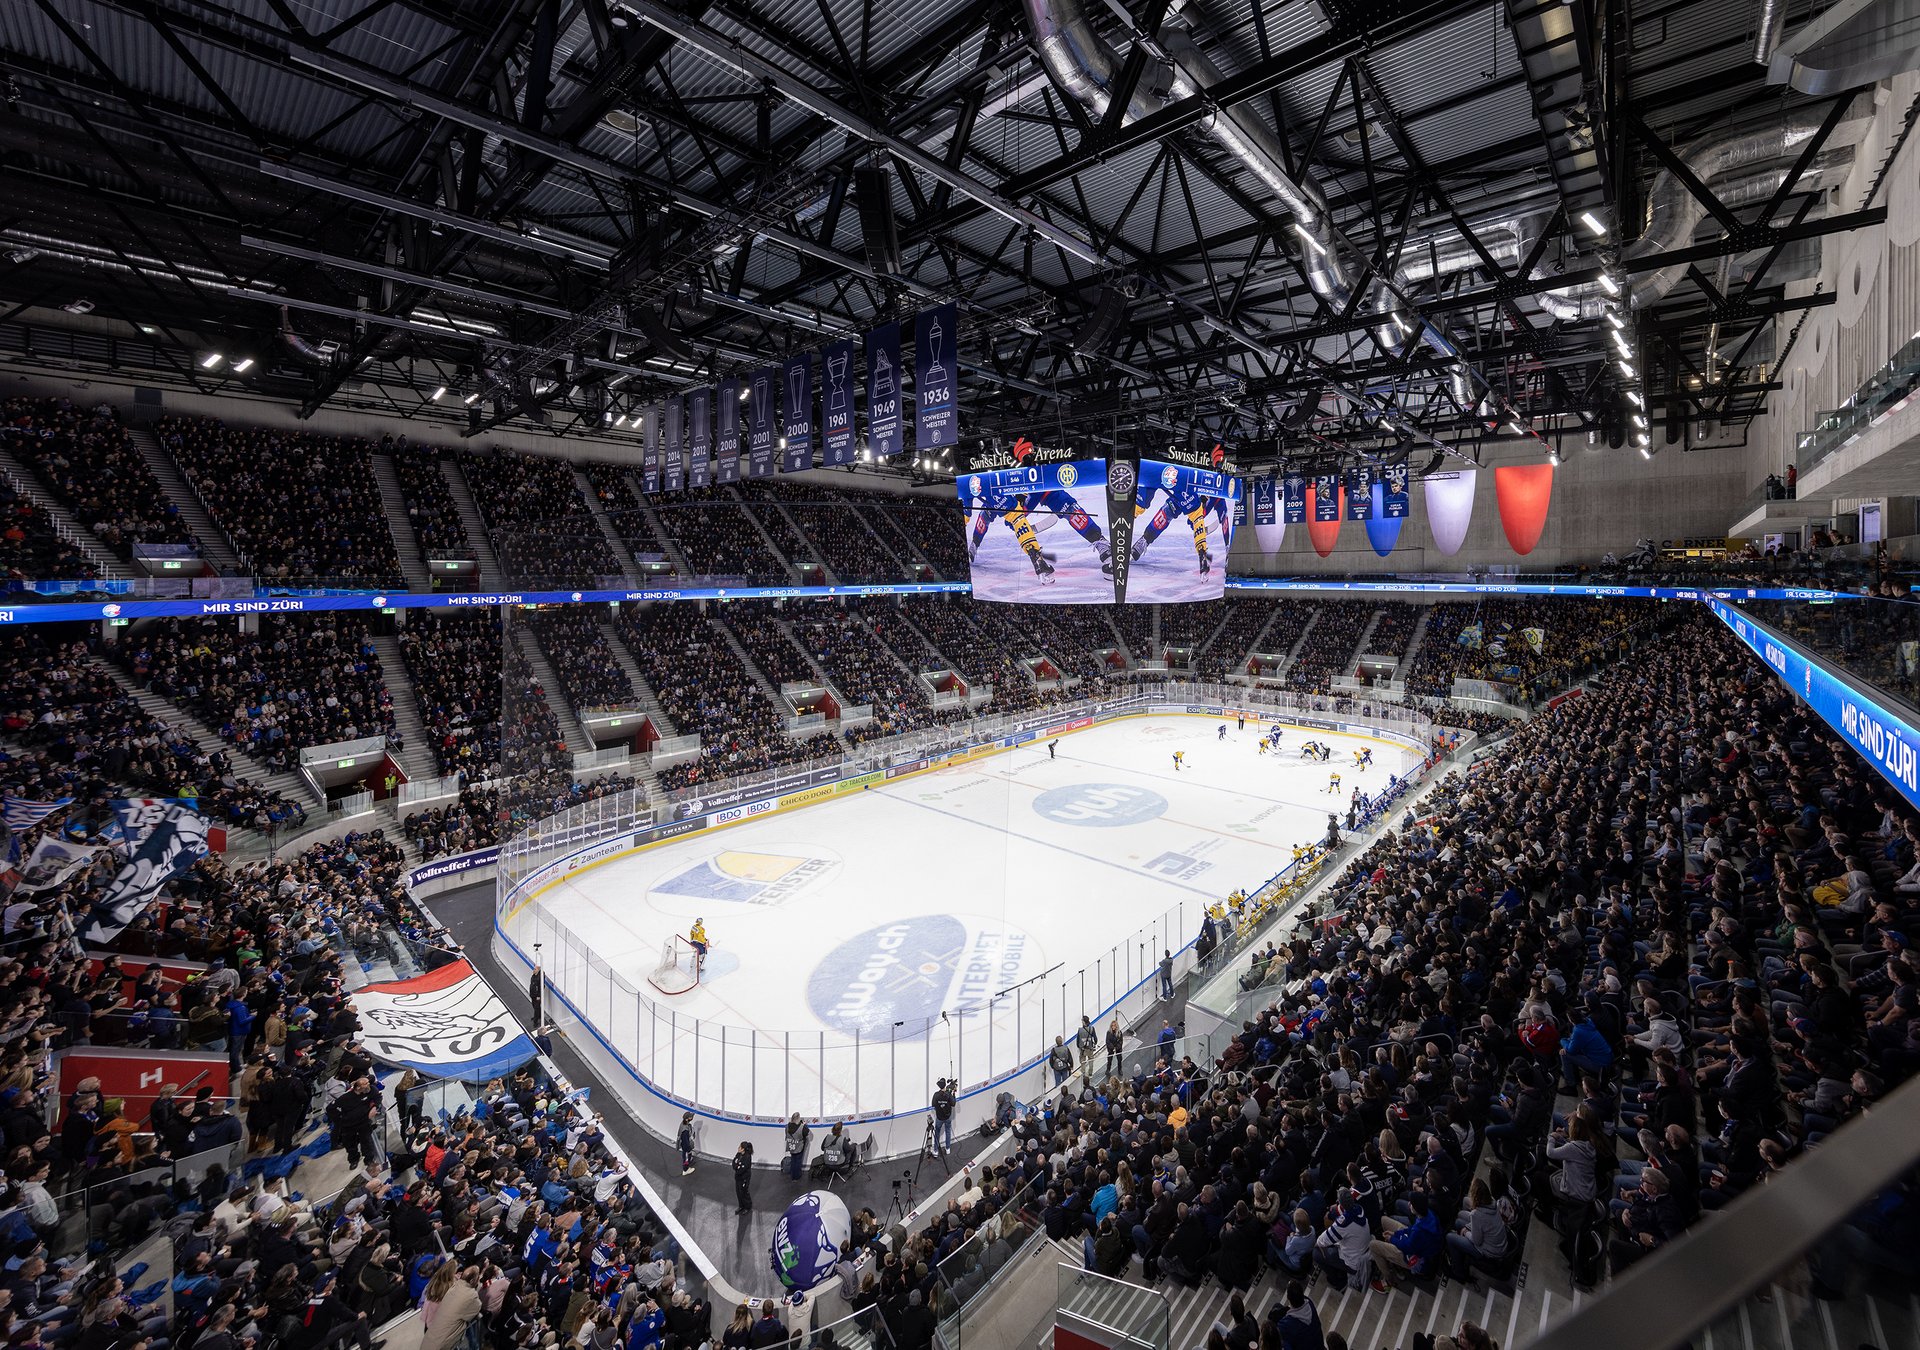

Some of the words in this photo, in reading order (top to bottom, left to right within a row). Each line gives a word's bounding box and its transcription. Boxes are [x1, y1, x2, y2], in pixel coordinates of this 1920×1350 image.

[923, 387, 950, 405] 1936
[873, 400, 896, 414] 1949
[828, 412, 848, 427] 1961
[922, 411, 951, 423] SCHWEIZER
[925, 418, 948, 429] MEISTER
[787, 422, 809, 437] 2000
[872, 422, 897, 433] SCHWEIZER
[753, 431, 770, 444] 2001
[827, 433, 850, 443] SCHWEIZER
[875, 429, 895, 440] MEISTER
[692, 445, 707, 457] 2012
[720, 439, 737, 451] 2008
[787, 442, 808, 450] SCHWEIZER
[830, 440, 847, 449] MEISTER
[667, 451, 681, 462] 2014
[1034, 447, 1073, 461] Arena
[995, 473, 1001, 486] 1
[1028, 468, 1038, 482] 0
[1194, 470, 1198, 484] 1
[1216, 475, 1222, 488] 0
[1662, 540, 1726, 548] CORNER
[1116, 530, 1126, 586] NORQAIN
[448, 597, 470, 605] MIR
[472, 596, 497, 605] SIND
[498, 595, 522, 604] ZÜRI
[626, 592, 643, 600] MIR
[664, 590, 681, 599] ZÜRI
[203, 603, 231, 613] MIR
[234, 602, 268, 612] SIND
[271, 599, 303, 611] ZÜRI
[1841, 698, 1858, 740] MIR
[1859, 711, 1884, 761] SIND
[1885, 728, 1917, 793] ZÜRI
[849, 773, 882, 786] TRACKER.COM
[707, 792, 743, 808] Volltreffer!
[780, 794, 809, 807] CHICCO
[750, 801, 771, 813] BDO
[719, 809, 742, 821] BDO
[581, 843, 624, 864] Zaunteam
[416, 858, 471, 881] Volltreffer!
[747, 857, 832, 906] FENSTER
[826, 924, 911, 1017] iway.ch
[952, 930, 1001, 1018] INTERNET
[140, 1067, 163, 1089] H
[777, 1216, 795, 1260] ewz
